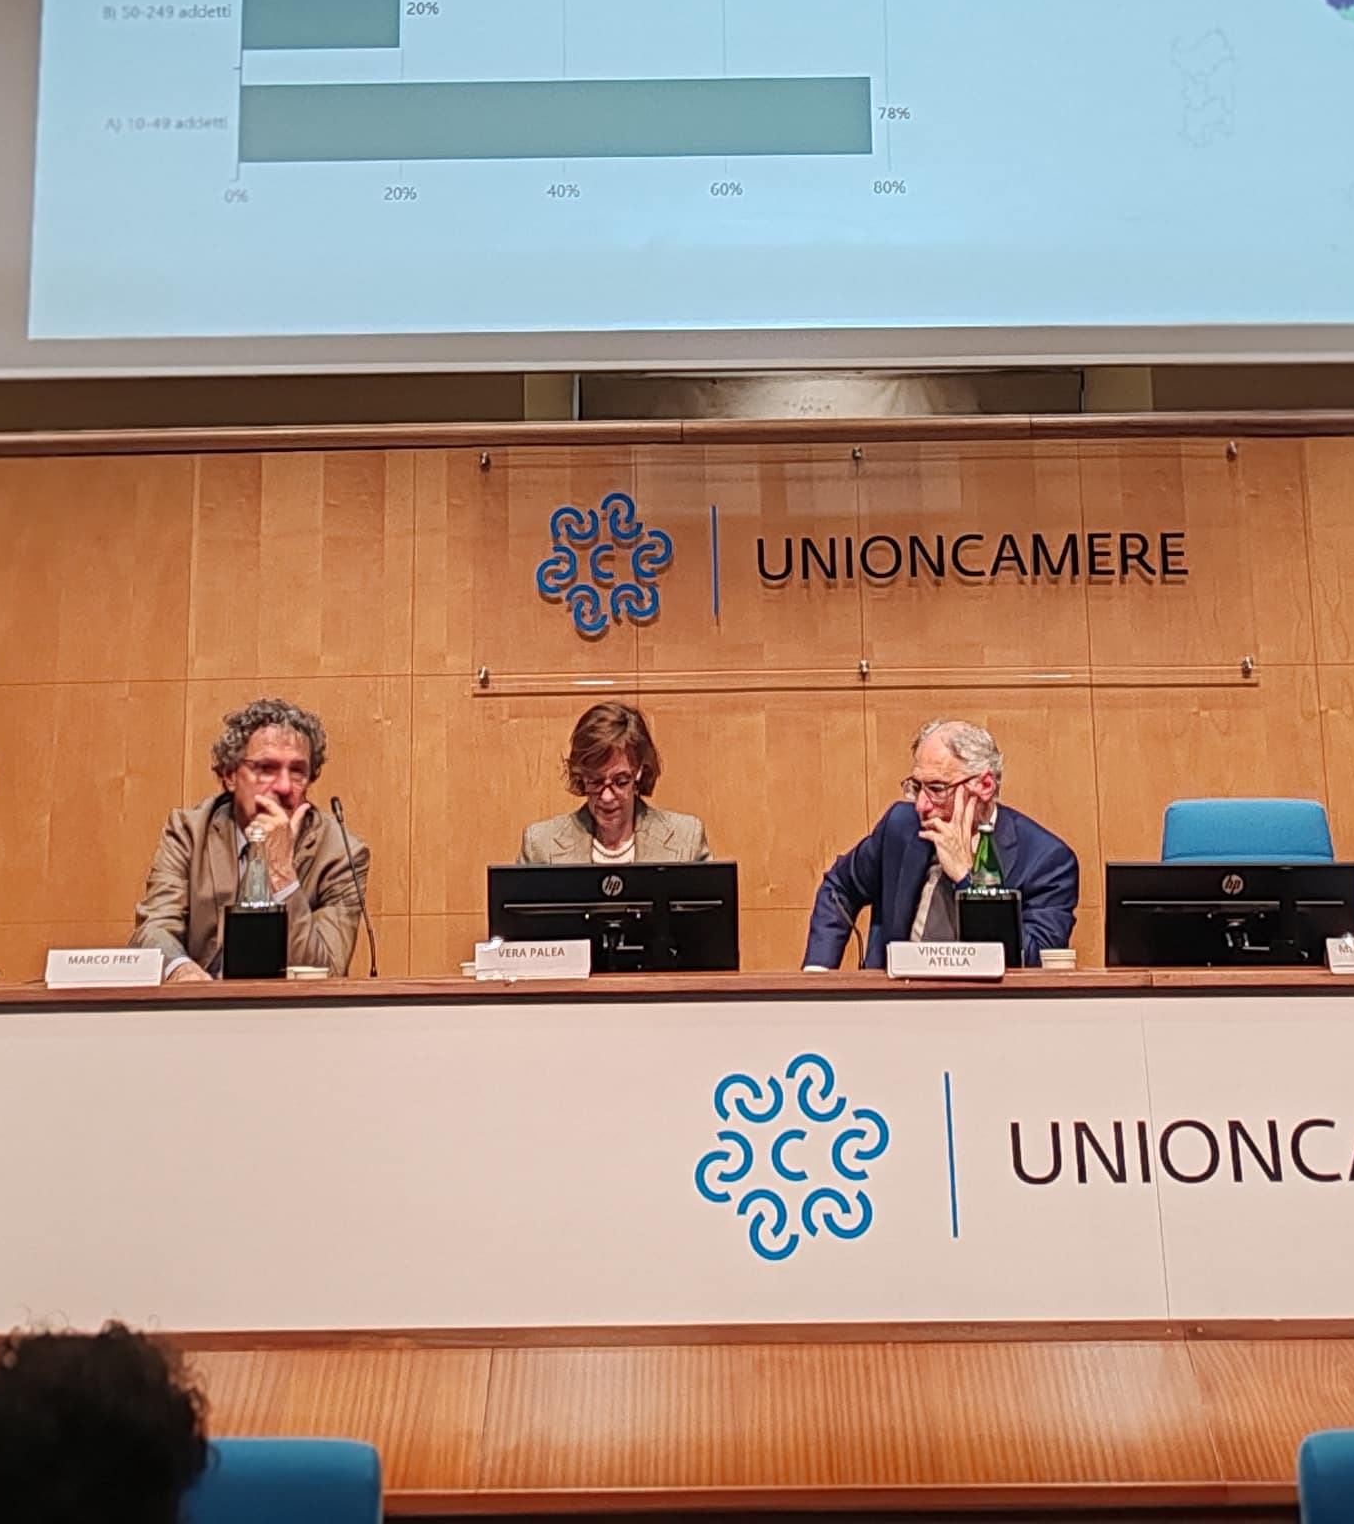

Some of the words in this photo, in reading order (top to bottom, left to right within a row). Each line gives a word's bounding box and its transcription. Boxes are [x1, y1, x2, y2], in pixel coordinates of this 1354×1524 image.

[179, 4, 232, 19] addetti
[406, 2, 440, 16] 20%
[877, 107, 911, 121] 78%
[175, 115, 229, 130] addetti
[224, 189, 249, 203] 0%
[384, 187, 417, 201] 20%
[547, 184, 580, 198] 40%
[710, 182, 743, 196] 60%
[873, 180, 906, 194] 80%
[755, 531, 1190, 581] UNIONCAMERE
[498, 948, 527, 958] VERA
[530, 947, 565, 957] PALEA
[917, 946, 976, 956] VINCENZO
[68, 955, 110, 965] MARCO
[113, 955, 140, 964] FREY
[928, 957, 970, 966] ATELLA
